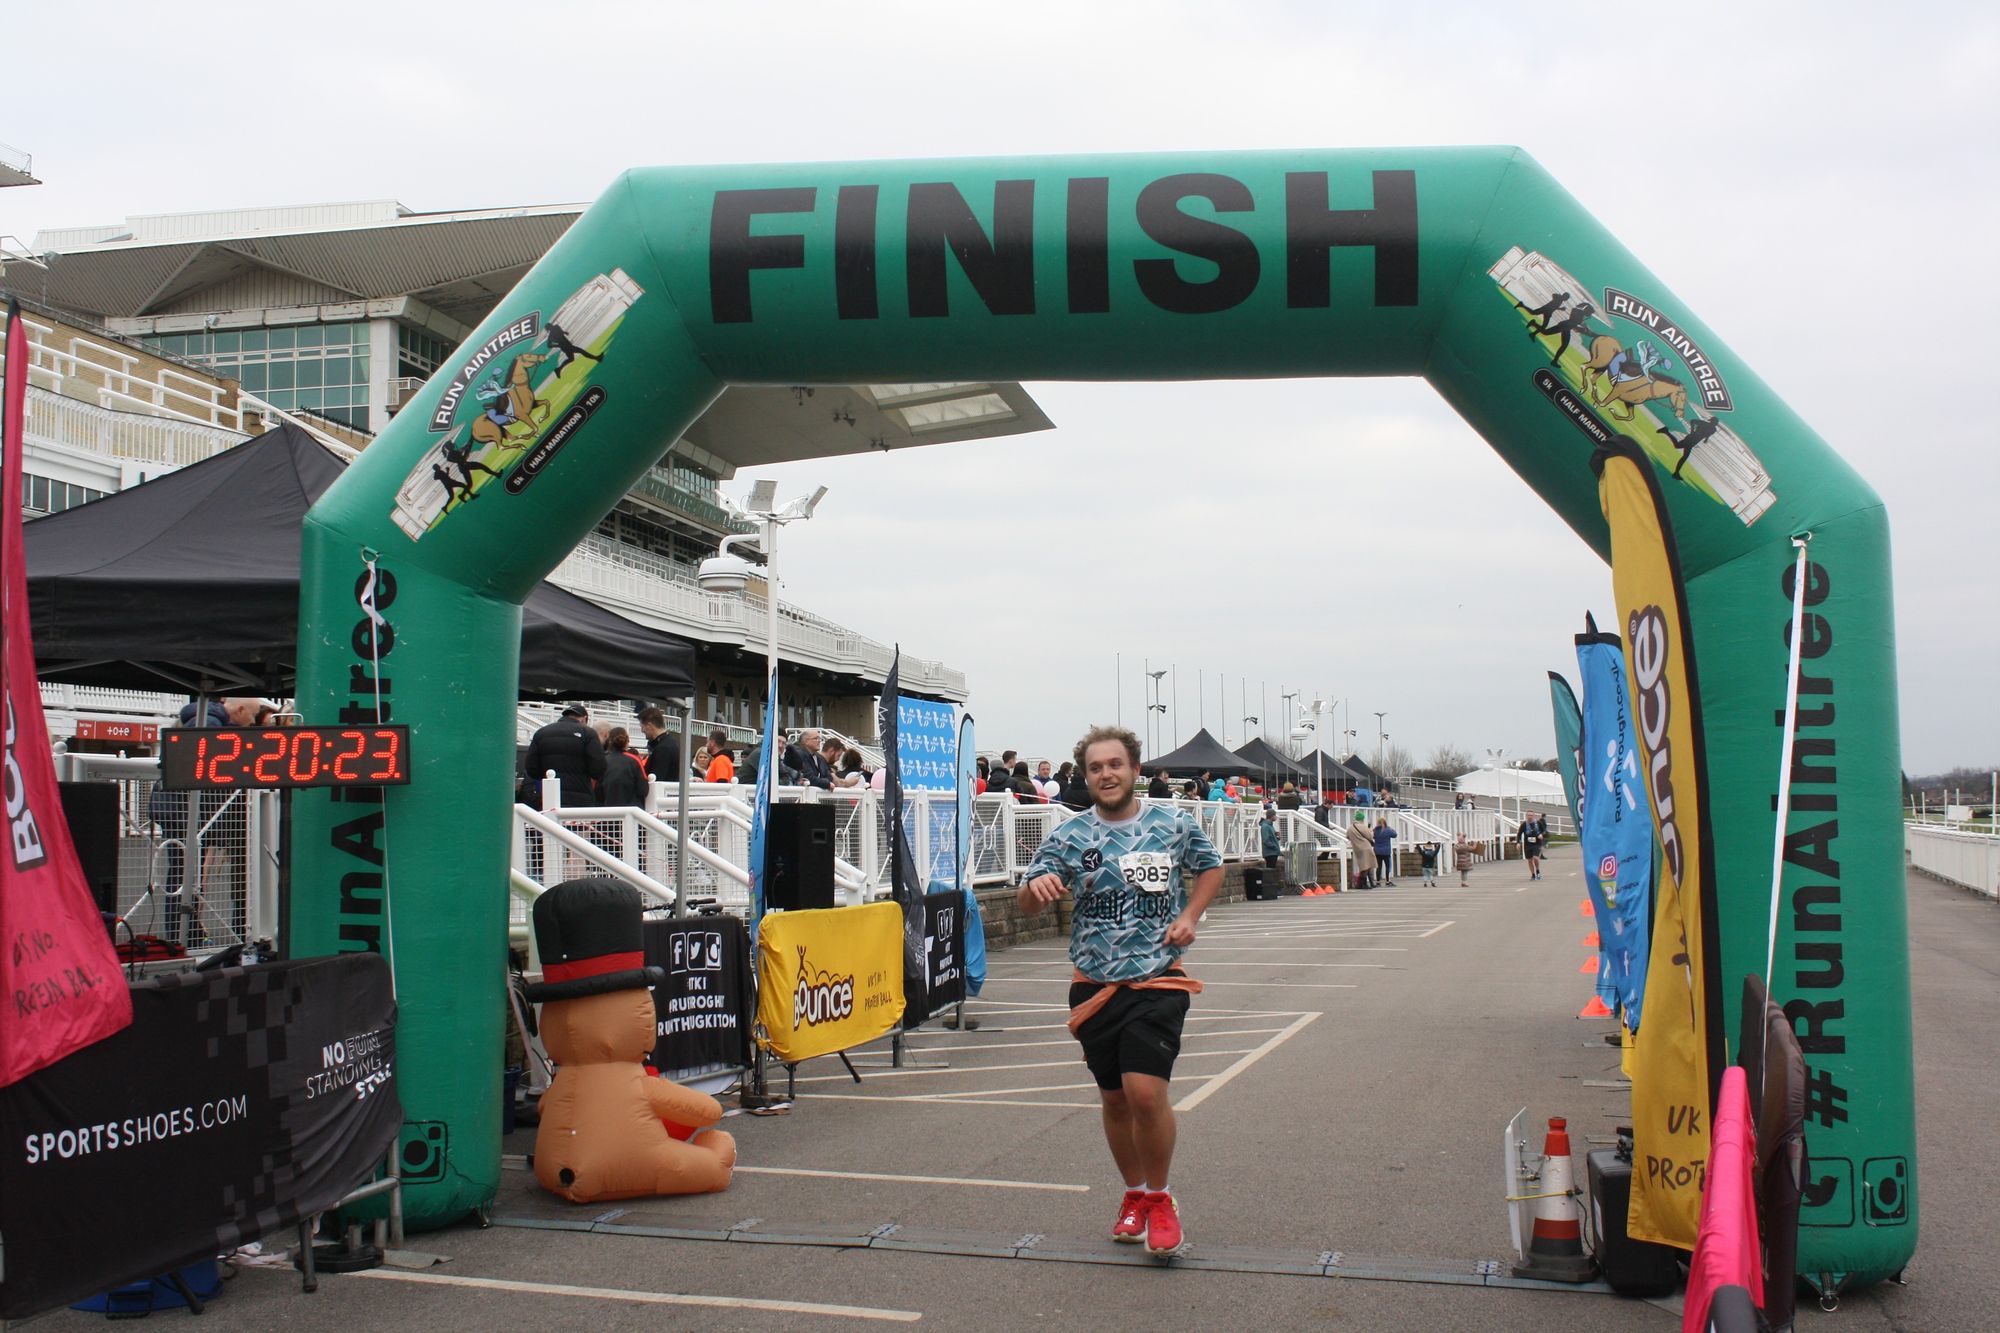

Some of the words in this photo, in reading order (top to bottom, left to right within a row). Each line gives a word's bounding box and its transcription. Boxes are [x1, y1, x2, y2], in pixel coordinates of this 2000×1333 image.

[708, 168, 1420, 324] FINISH
[435, 381, 465, 425] RUN
[463, 319, 533, 380] AINTREE
[1612, 295, 1661, 328] RUN
[1660, 326, 1724, 403] AINTREE
[1542, 378, 1553, 390] 5k
[1560, 395, 1581, 415] HALF
[513, 475, 525, 486] 5k
[529, 449, 548, 470] HALF
[546, 411, 582, 452] MARATHON
[585, 392, 601, 408] 10k
[195, 730, 400, 783] 12:20:23
[1123, 865, 1170, 883] 2083
[793, 977, 853, 1030] Bounce
[323, 1041, 345, 1069] NO
[345, 1029, 381, 1060] FUN
[306, 1053, 382, 1099] STANDING
[25, 1094, 248, 1164] SPORTSSHOES.COM
